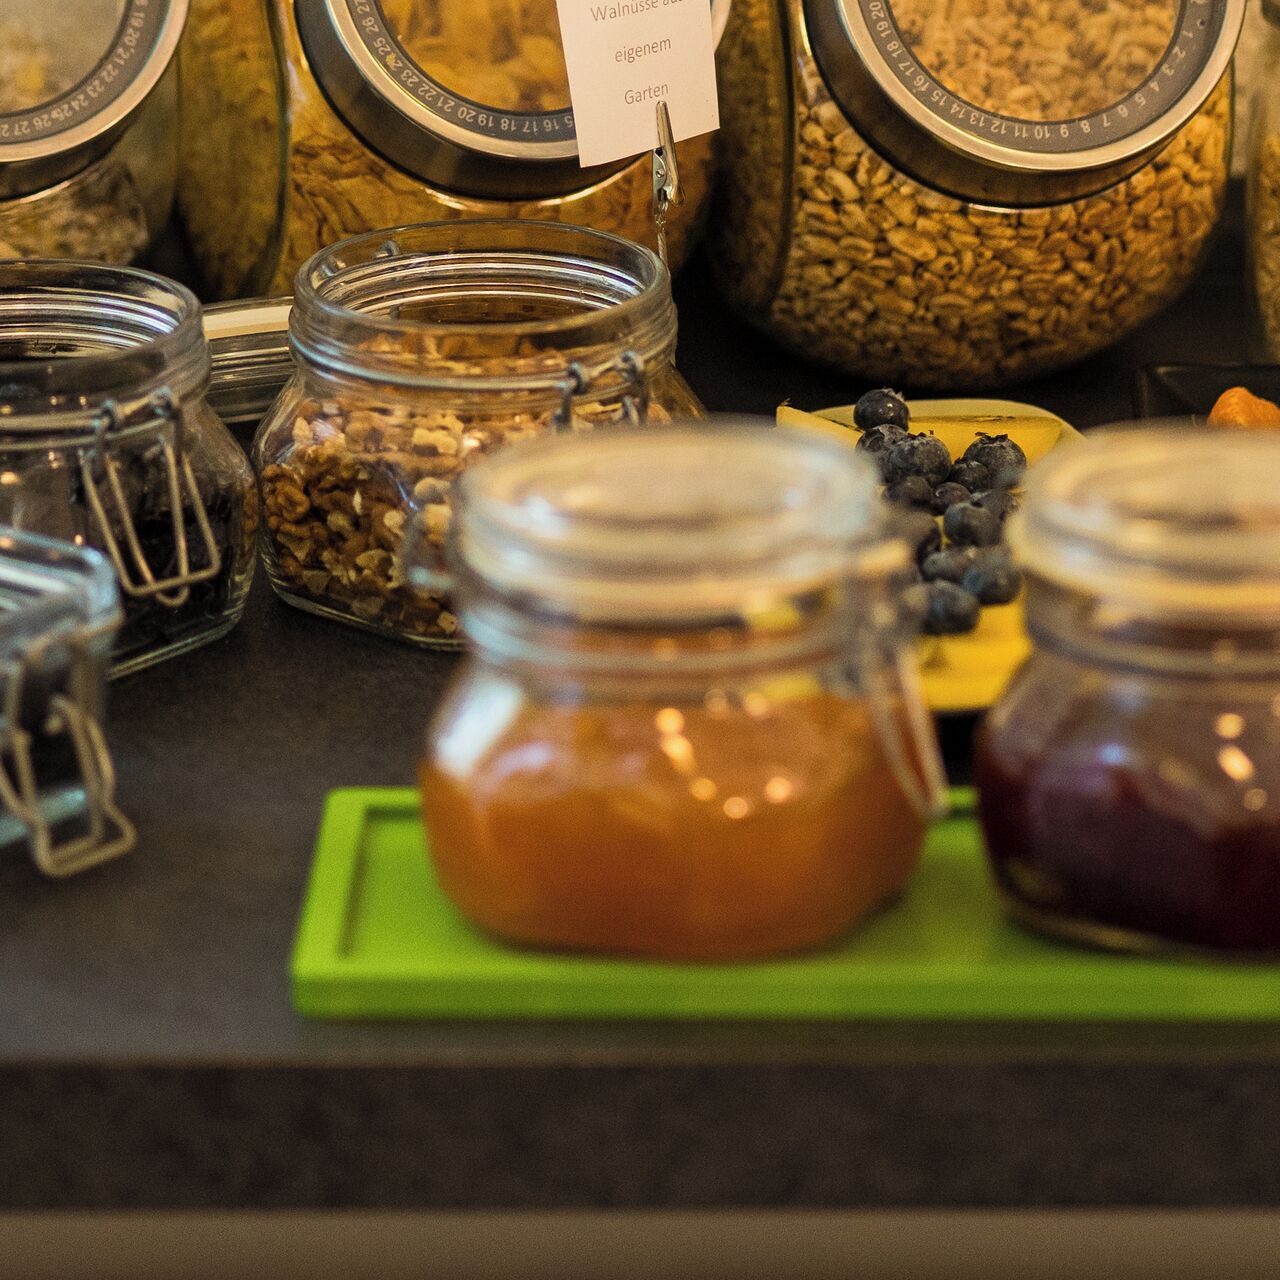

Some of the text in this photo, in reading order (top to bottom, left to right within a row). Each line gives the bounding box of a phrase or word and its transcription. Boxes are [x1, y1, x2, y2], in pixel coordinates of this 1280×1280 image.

[868, 1, 885, 20] 20
[361, 16, 379, 33] 26
[876, 20, 892, 38] 19
[123, 27, 140, 46] 20
[1181, 30, 1194, 39] 1
[373, 37, 392, 56] 25
[615, 37, 672, 64] eigenem
[886, 40, 903, 58] 18
[1172, 46, 1187, 60] 2
[114, 48, 131, 65] 21
[101, 63, 119, 83] 22
[898, 61, 915, 77] 17
[1161, 63, 1175, 77] 3
[400, 69, 420, 87] 23
[913, 75, 930, 92] 16
[1149, 80, 1160, 92] 4
[86, 79, 105, 98] 23
[417, 83, 437, 101] 22
[624, 83, 669, 105] Garten
[70, 94, 89, 111] 24
[436, 96, 456, 113] 21
[930, 89, 947, 107] 15
[1134, 93, 1147, 107] 5
[457, 106, 477, 122] 20
[950, 103, 970, 119] 14
[969, 111, 987, 127] 13
[1116, 104, 1129, 118] 6
[13, 120, 31, 136] 27
[32, 114, 52, 130] 26
[477, 113, 494, 128] 19
[500, 117, 517, 132] 18
[522, 120, 538, 133] 17
[542, 119, 560, 132] 16
[990, 118, 1007, 135] 12
[1079, 120, 1091, 134] 8
[1102, 113, 1111, 128] 7
[1014, 123, 1029, 139] 11
[1033, 125, 1051, 140] 10
[1059, 124, 1070, 138] 9
